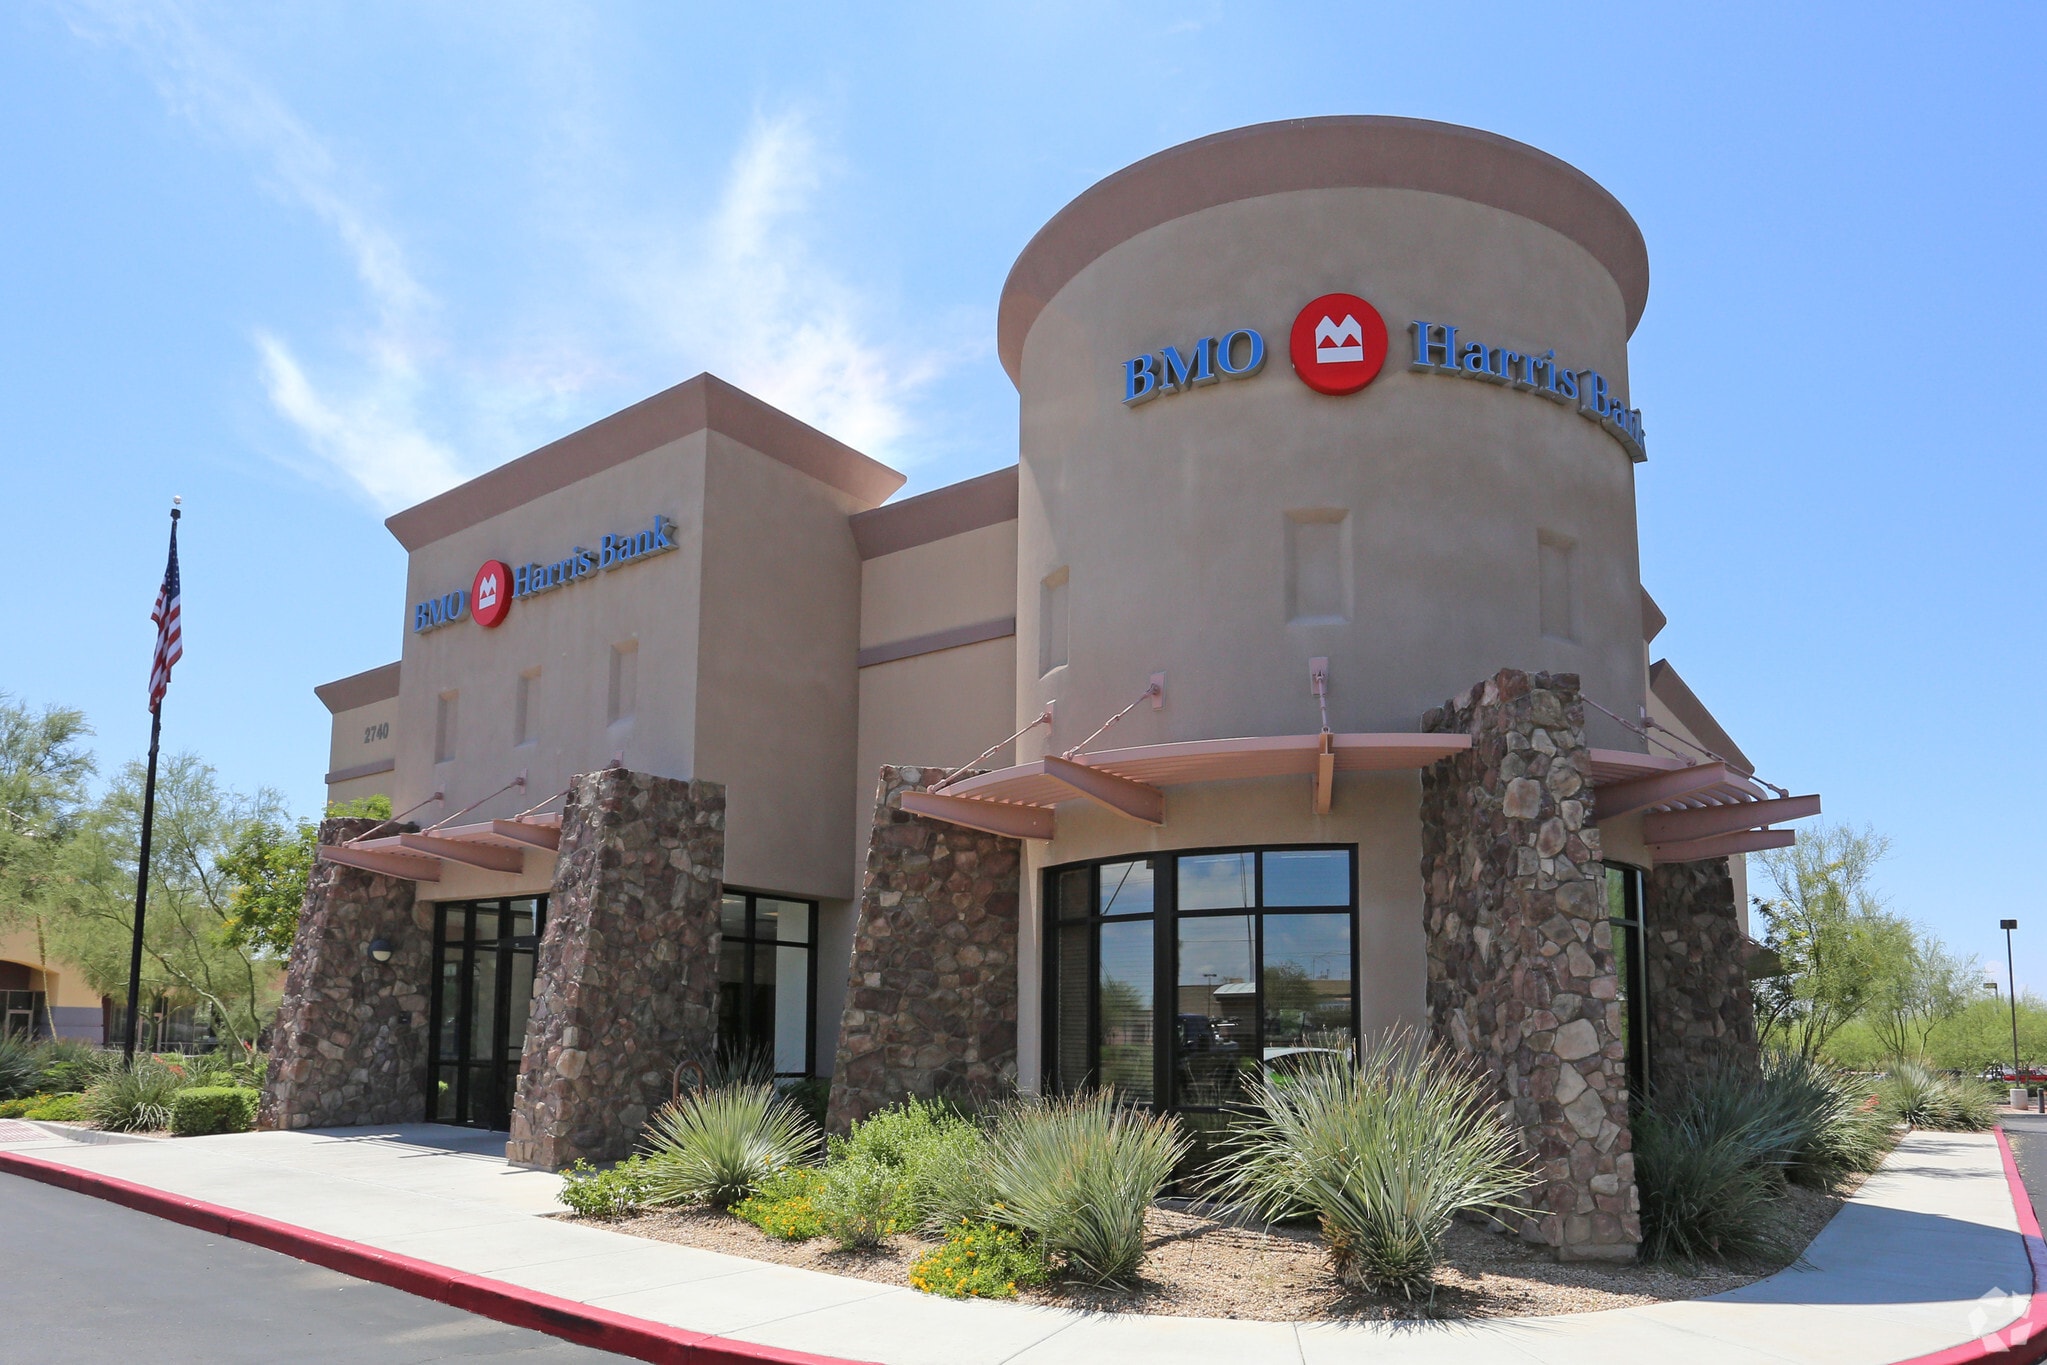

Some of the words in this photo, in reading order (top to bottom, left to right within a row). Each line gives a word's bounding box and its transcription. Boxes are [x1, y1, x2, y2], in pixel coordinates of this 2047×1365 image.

[1123, 328, 1265, 406] BMO
[1410, 320, 1580, 403] Harris
[1579, 367, 1647, 463] Ban
[414, 588, 466, 634] BMO
[512, 546, 598, 600] Harris
[598, 514, 679, 572] Bank
[364, 722, 389, 744] 2740
